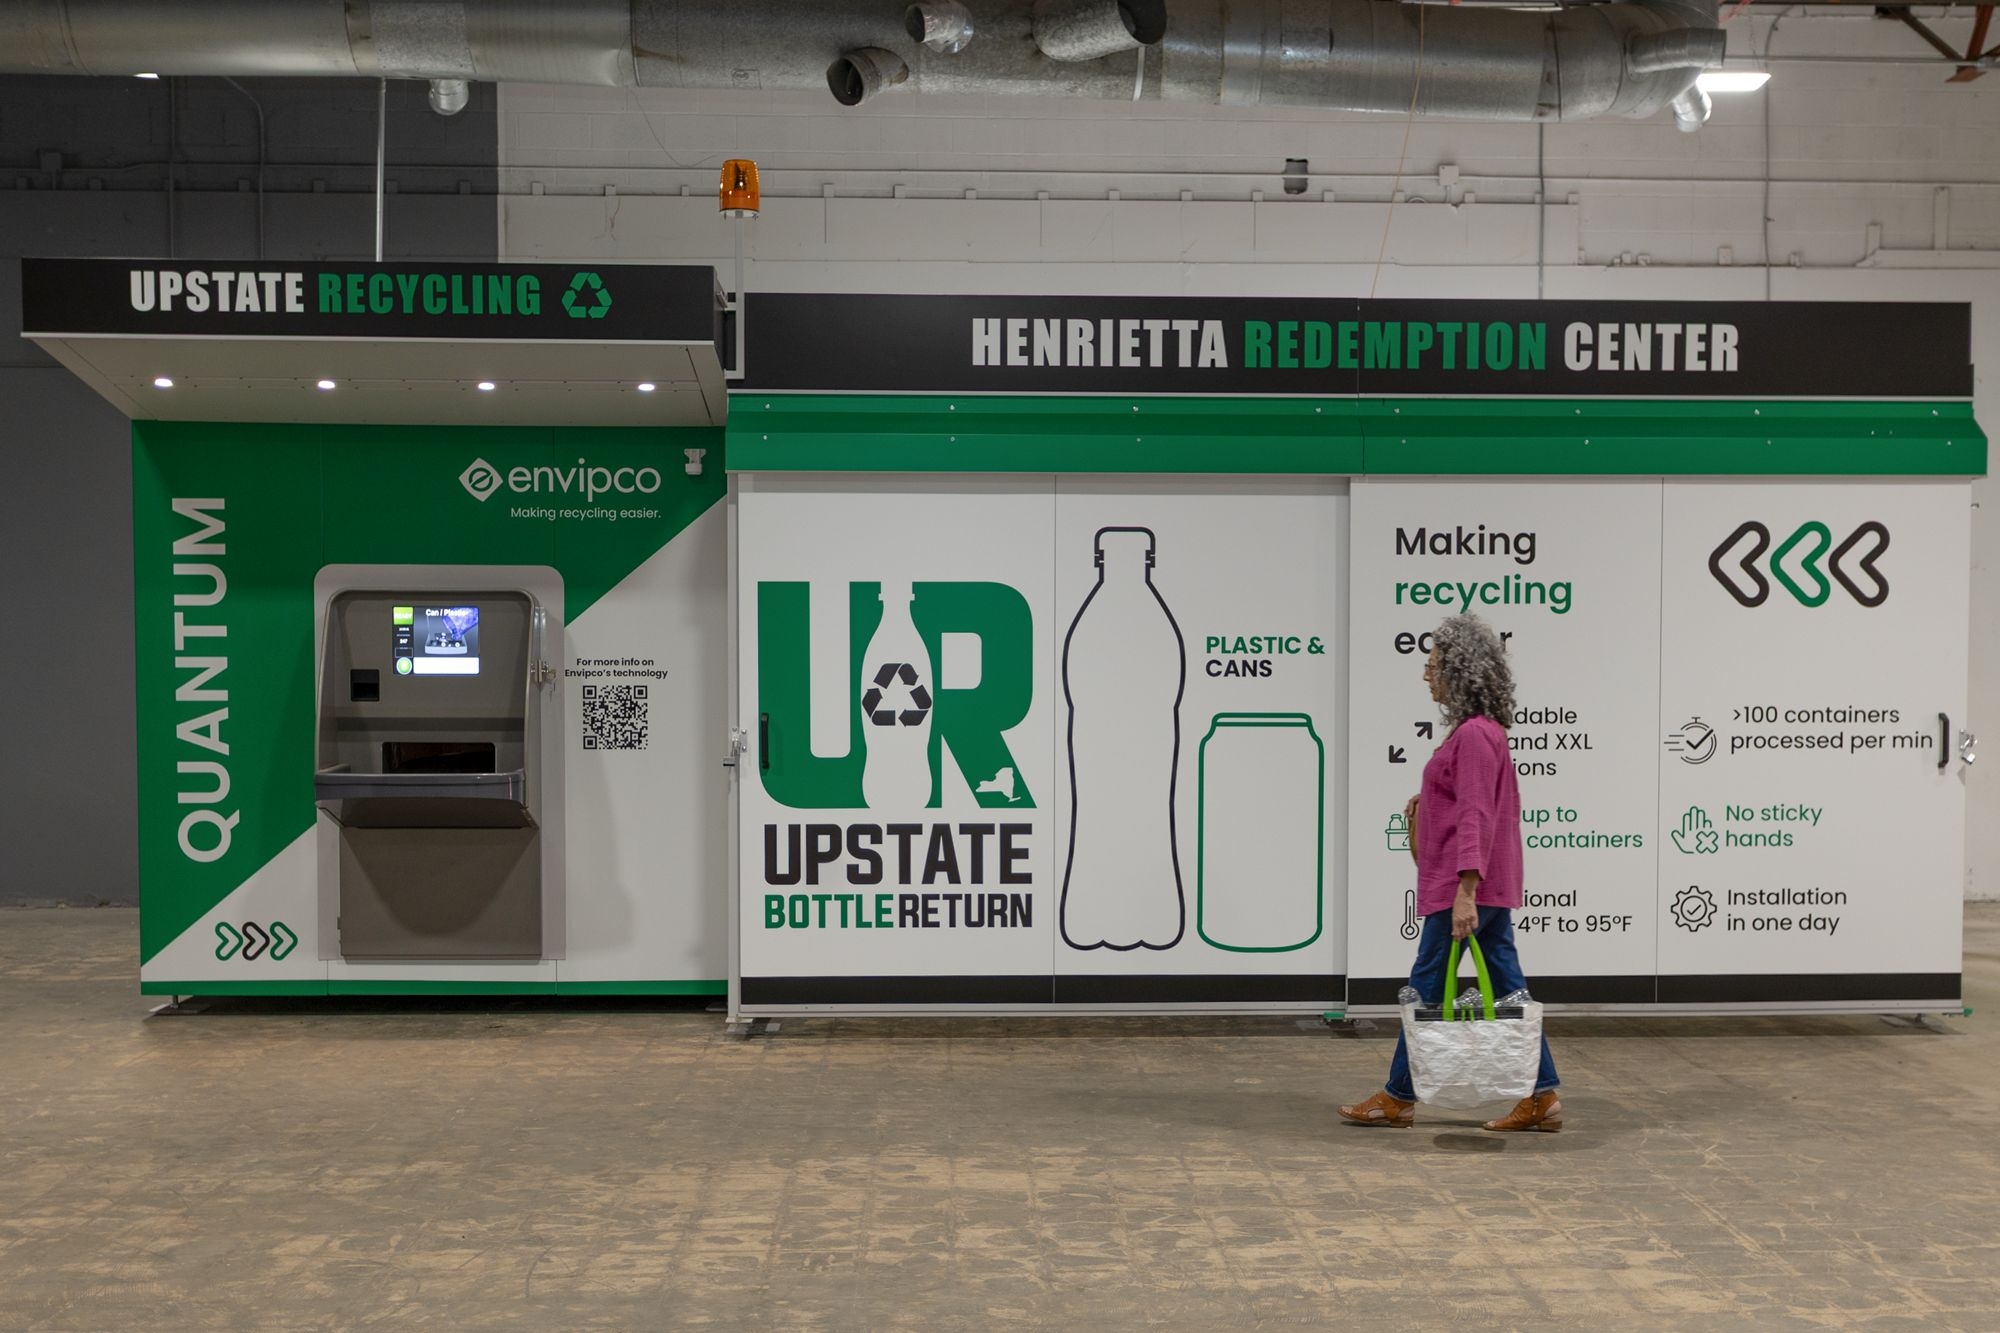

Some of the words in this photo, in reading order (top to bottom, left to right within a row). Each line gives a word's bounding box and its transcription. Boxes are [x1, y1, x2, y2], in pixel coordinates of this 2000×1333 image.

[130, 270, 304, 312] UPSTATE
[319, 273, 541, 315] RECYCLING
[972, 318, 1228, 369] HENRIETTA
[1244, 321, 1546, 371] REDEMPTION
[1564, 322, 1739, 371] CENTER
[508, 458, 661, 502] envipco
[511, 507, 556, 521] Making
[559, 507, 617, 522] recycling
[620, 507, 661, 519] easier.
[1395, 525, 1537, 565] Making
[1395, 574, 1572, 614] recycling
[1206, 636, 1302, 655] PLASTIC
[1306, 637, 1326, 655] &
[576, 658, 591, 667] For
[594, 659, 620, 668] more
[622, 658, 641, 668] info
[642, 660, 655, 668] on
[1206, 658, 1273, 678] CANS
[172, 498, 240, 862] QUANTUM
[613, 668, 669, 681] technology
[1785, 704, 1900, 723] containers
[1507, 733, 1547, 750] and
[1555, 733, 1593, 750] XXL
[1730, 731, 1844, 755] processed
[1850, 735, 1886, 754] per
[1891, 731, 1933, 748] min
[1522, 809, 1550, 828] up
[1556, 807, 1578, 822] to
[1725, 805, 1755, 822] No
[1760, 804, 1823, 826] sticky
[1527, 830, 1643, 848] containers
[1724, 830, 1794, 848] hands
[764, 823, 1033, 885] UPSTATE
[1727, 887, 1847, 906] Installation
[1557, 916, 1579, 933] to
[1727, 913, 1746, 931] in
[1751, 917, 1792, 931] one
[1798, 913, 1841, 936] day
